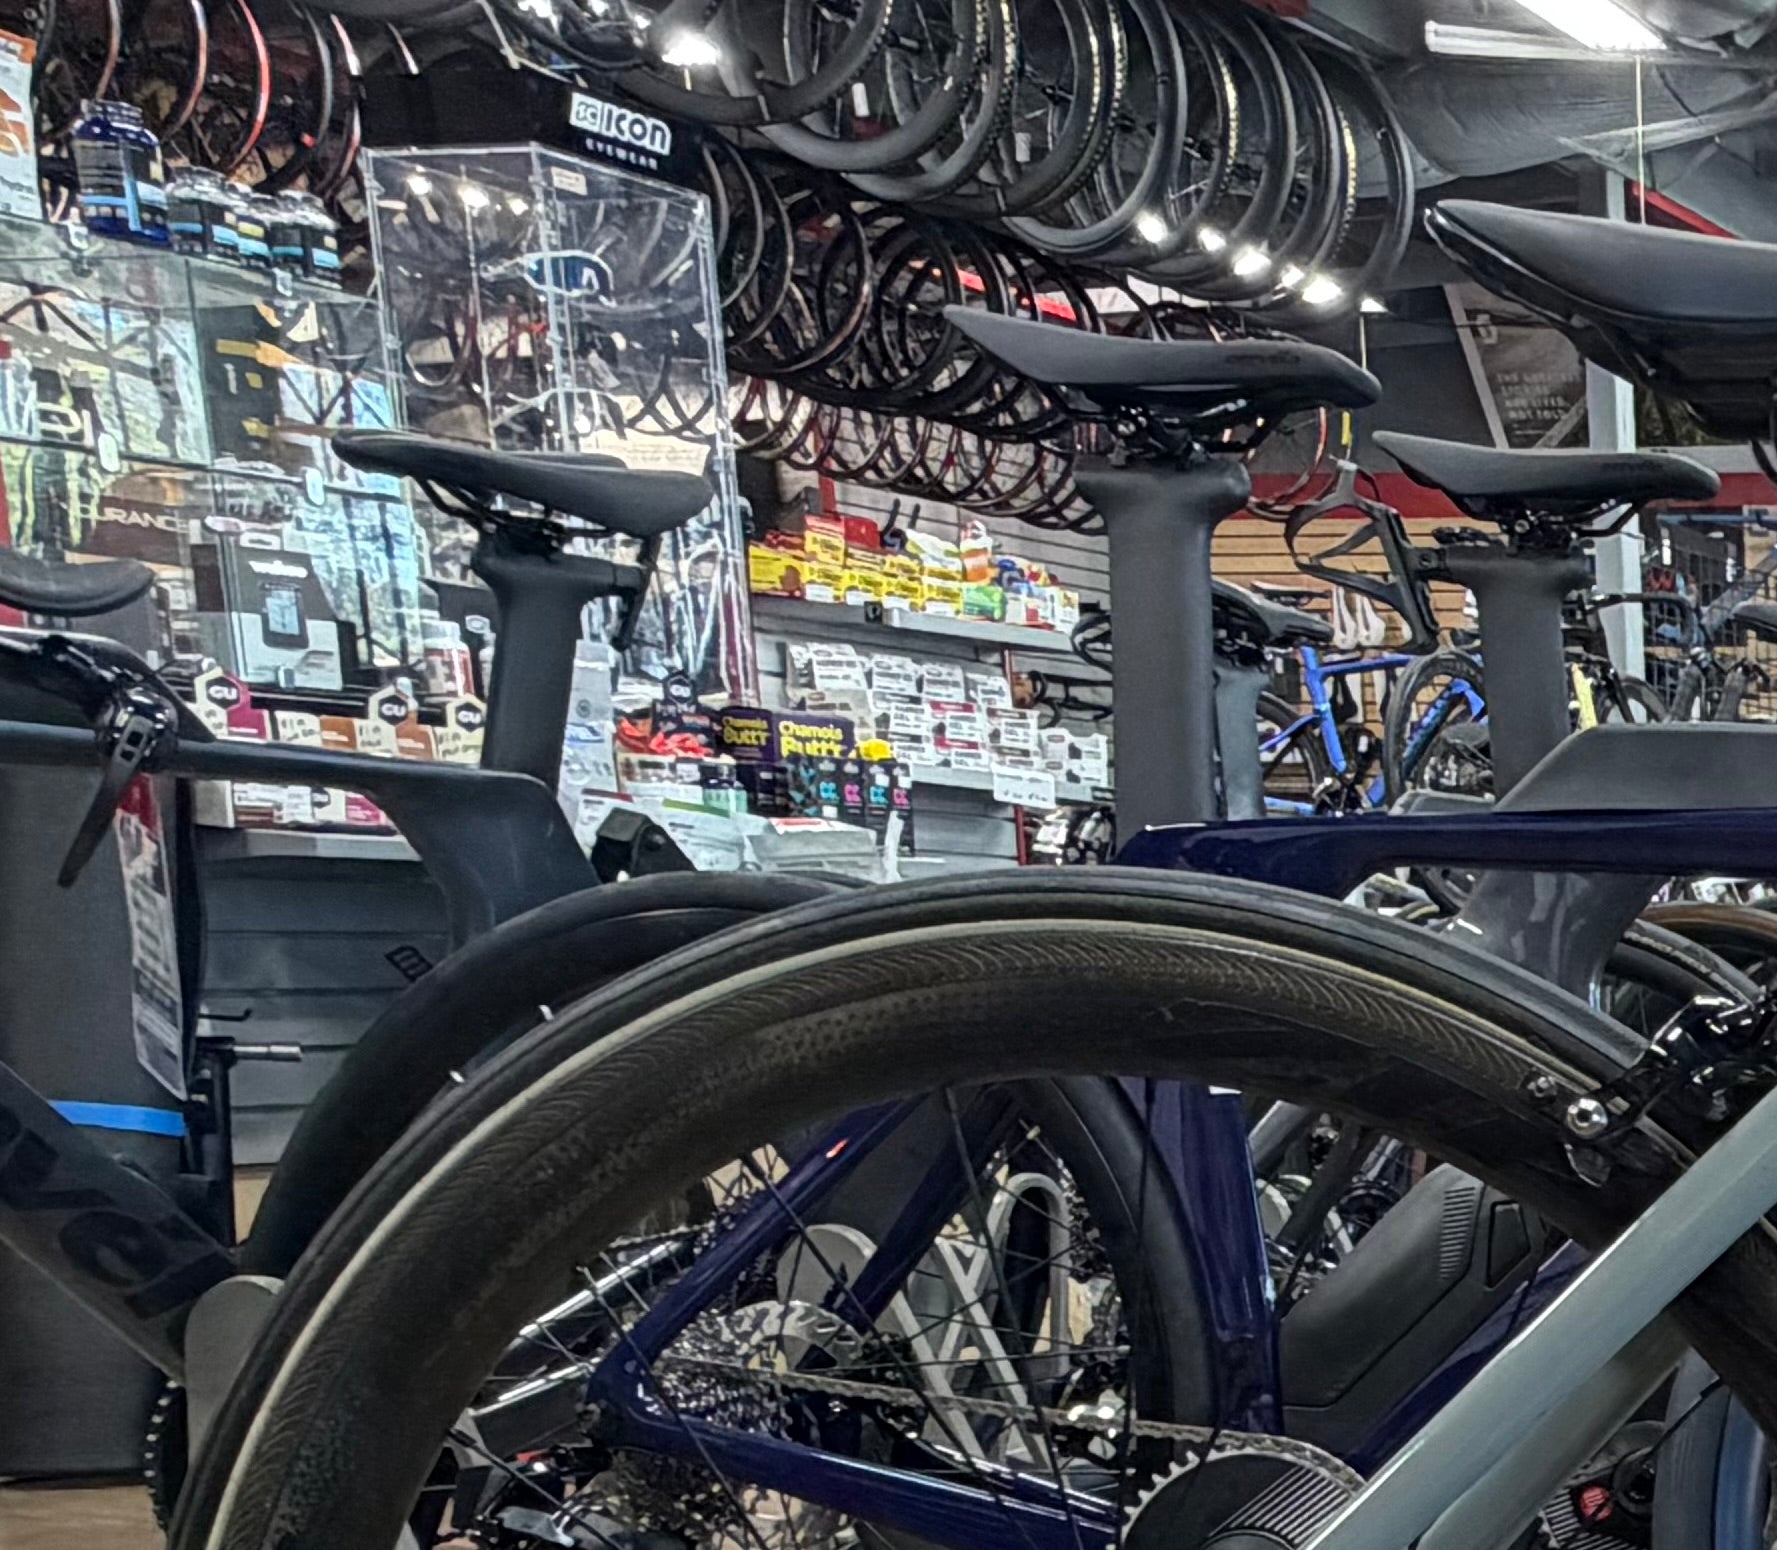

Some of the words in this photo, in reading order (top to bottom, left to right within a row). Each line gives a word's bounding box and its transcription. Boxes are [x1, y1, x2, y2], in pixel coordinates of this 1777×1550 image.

[209, 684, 238, 700] GU
[382, 703, 406, 717] GU
[779, 719, 844, 741] Chamois
